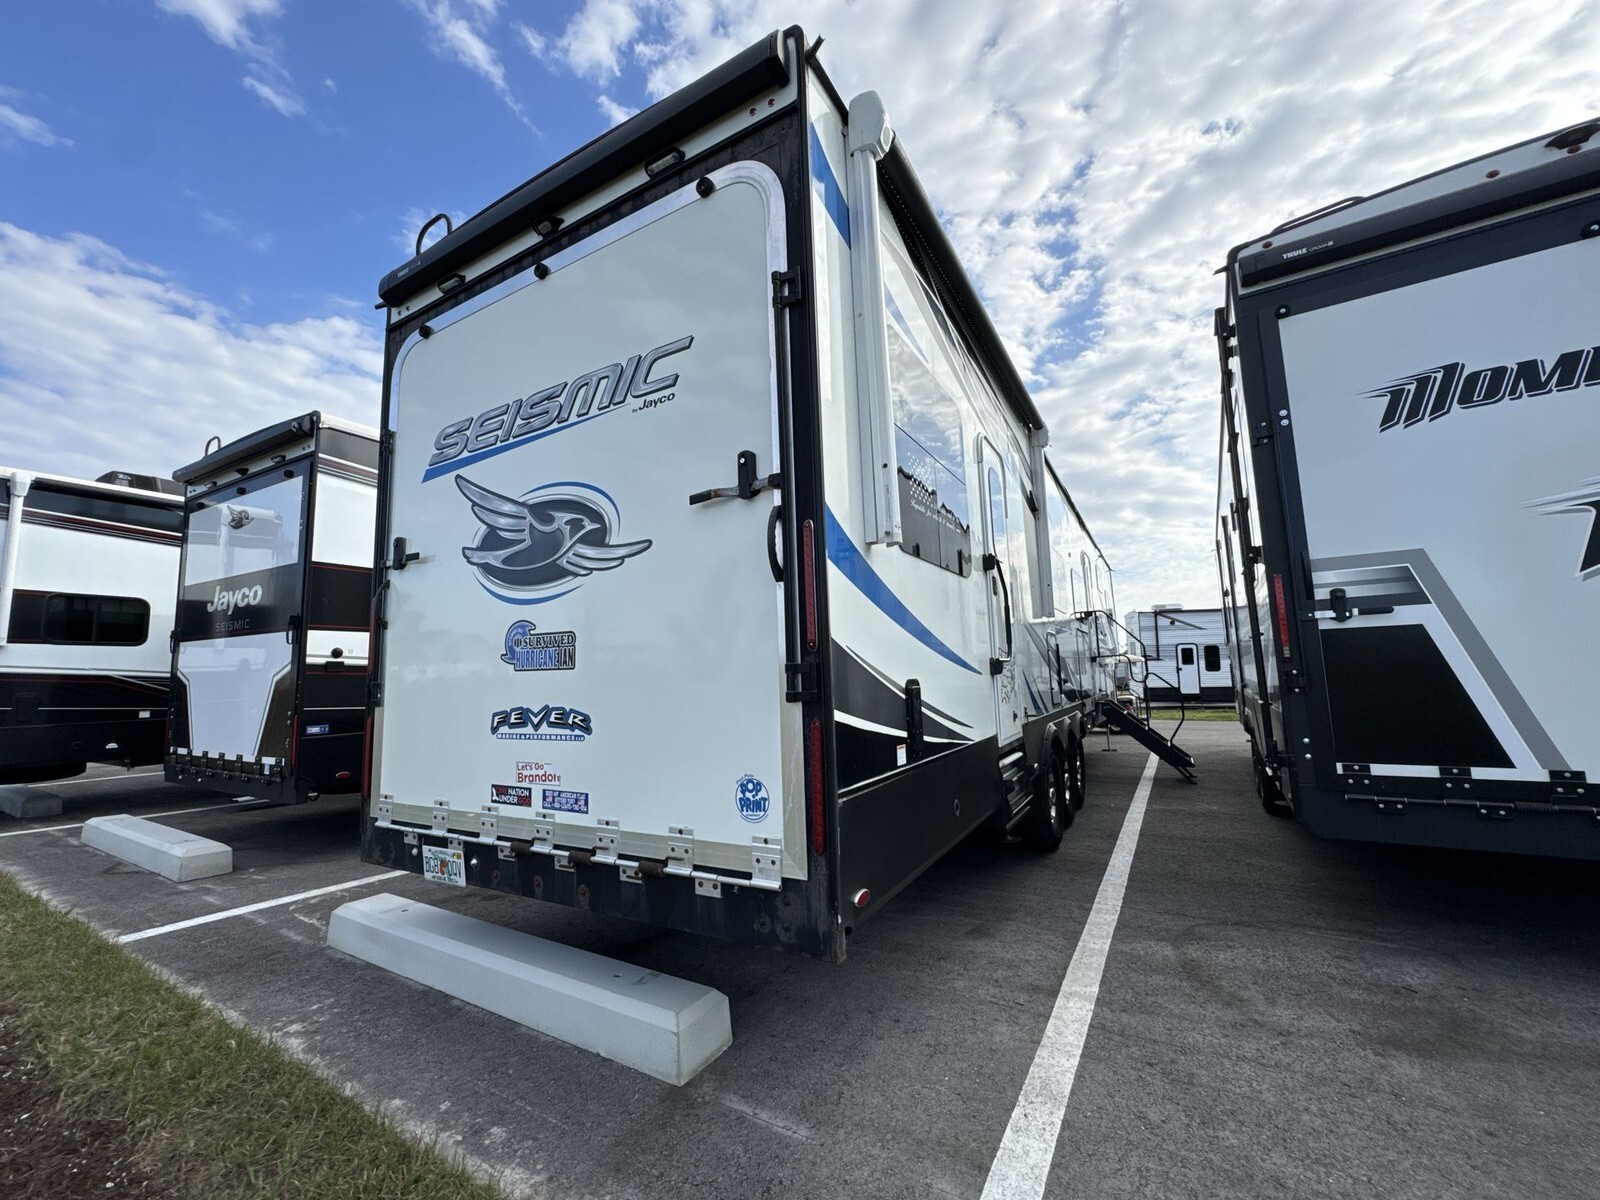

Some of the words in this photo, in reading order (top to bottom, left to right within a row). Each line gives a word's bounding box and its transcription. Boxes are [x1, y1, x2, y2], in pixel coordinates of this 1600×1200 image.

[1282, 247, 1308, 259] THULE
[428, 335, 694, 467] SEISMIC
[638, 392, 676, 412] Jayco
[207, 584, 263, 615] Jayco
[216, 619, 250, 632] SEISMIC
[523, 634, 574, 647] SURVIVED
[515, 648, 558, 669] HURRICANE
[559, 647, 574, 668] IAN
[491, 704, 592, 735] FEVER
[517, 763, 533, 771] Let's
[534, 762, 544, 771] Go
[517, 770, 560, 783] Brandon
[508, 788, 530, 796] NATION
[740, 779, 762, 797] POP
[499, 795, 518, 803] UNDER
[518, 797, 531, 805] GOD
[739, 797, 768, 813] PRINT
